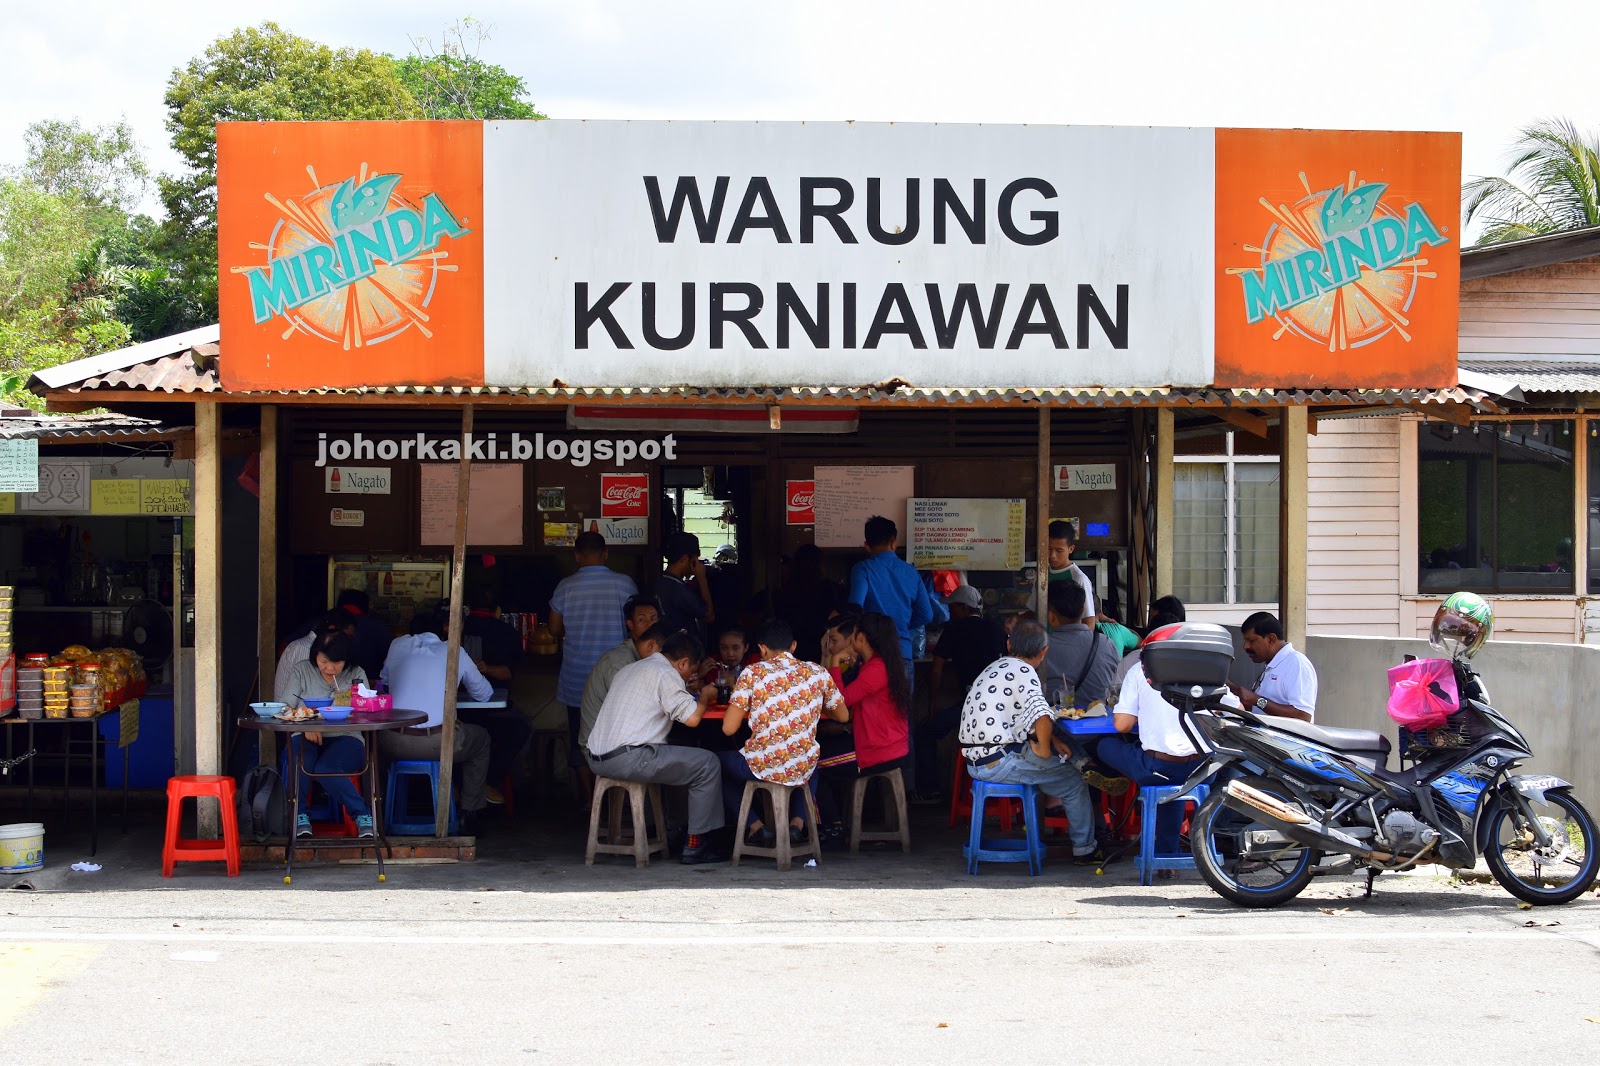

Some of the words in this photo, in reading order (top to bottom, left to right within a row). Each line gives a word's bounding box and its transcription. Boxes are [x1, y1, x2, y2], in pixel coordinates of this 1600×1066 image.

[642, 175, 1060, 246] WARUNG
[241, 192, 473, 324] MIRINDA
[1237, 201, 1451, 324] MIRINDA
[574, 281, 1130, 350] KURNIAWAN
[347, 472, 387, 492] Nagato
[1075, 470, 1112, 490] Nagato
[606, 486, 643, 499] Coca-Cola
[792, 493, 815, 506] Coca-C
[606, 524, 644, 543] Nagato
